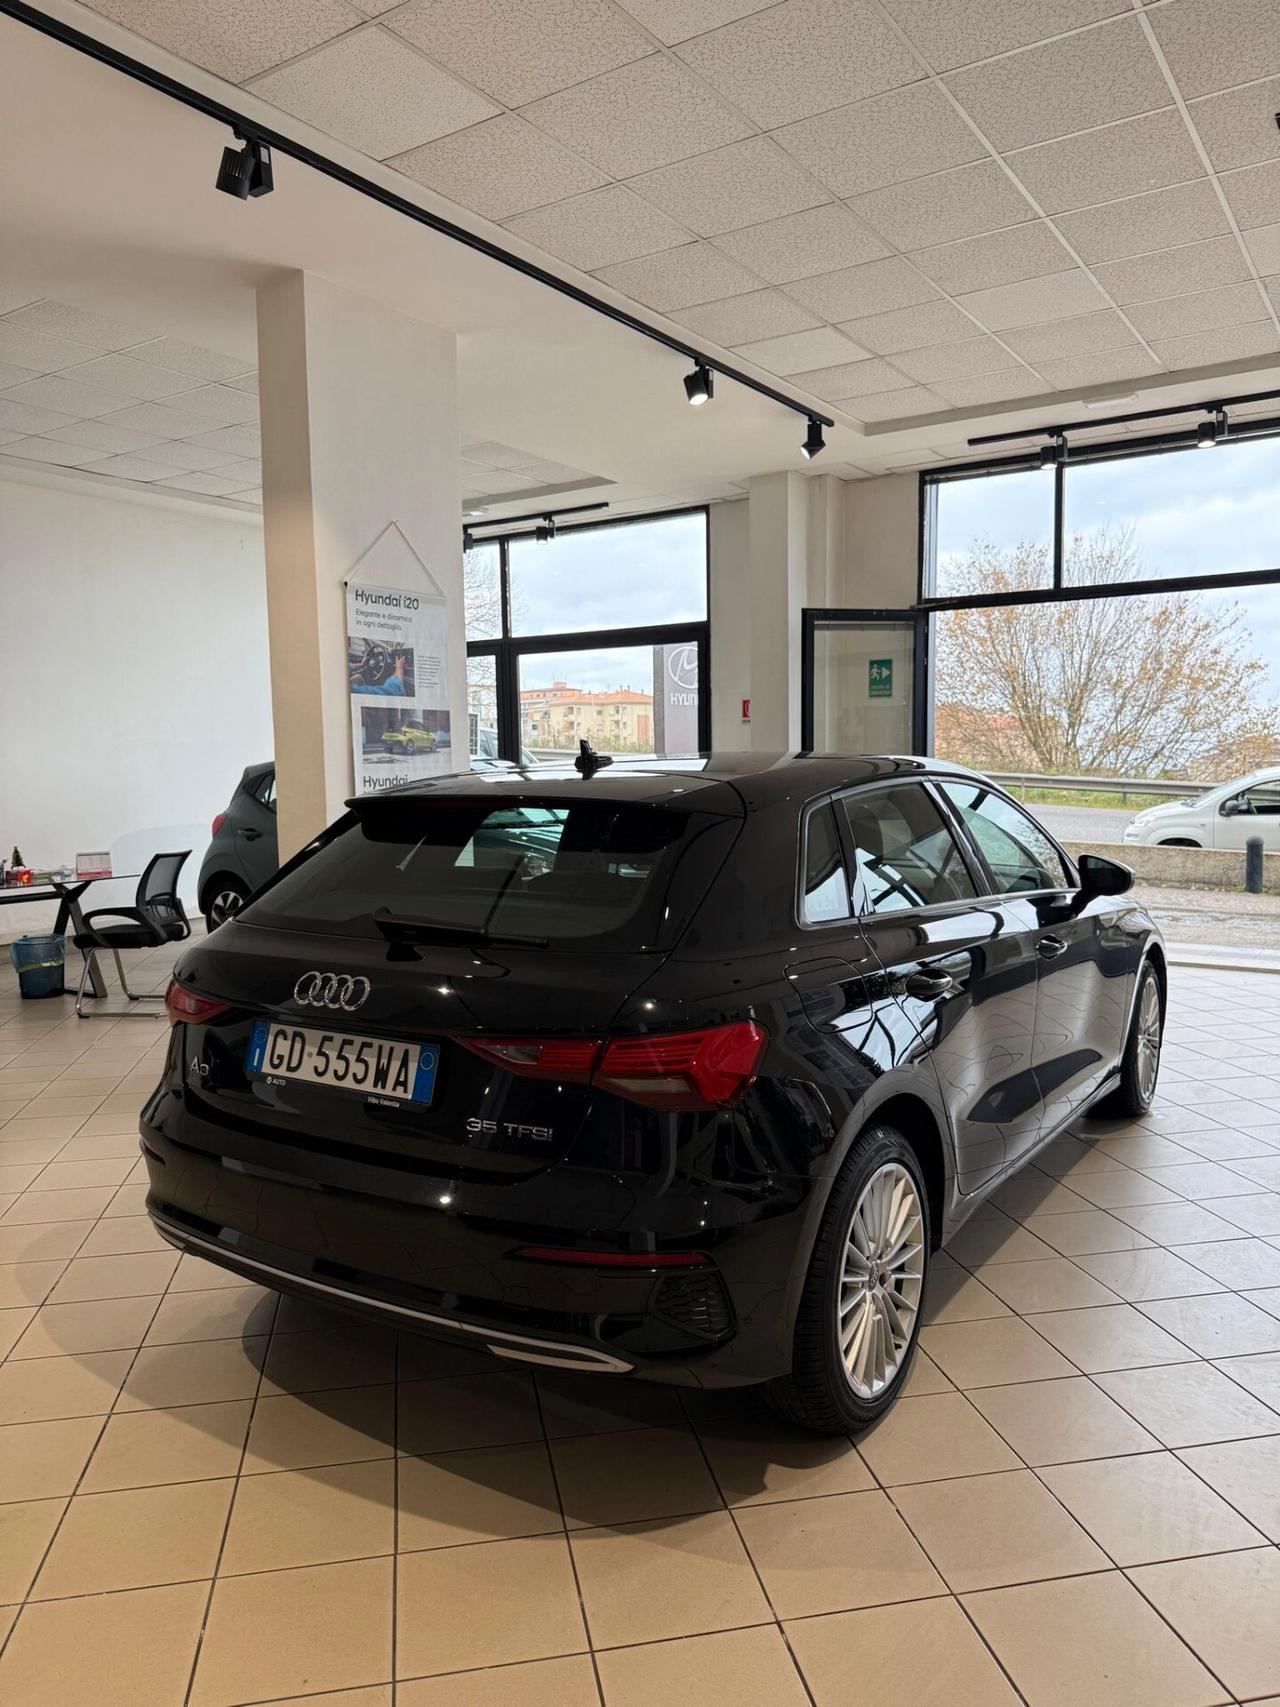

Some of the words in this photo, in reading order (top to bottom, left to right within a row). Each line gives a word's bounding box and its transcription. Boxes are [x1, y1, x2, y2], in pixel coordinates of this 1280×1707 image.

[355, 589, 401, 607] Hyundai
[404, 596, 419, 610] i20
[355, 608, 381, 619] Elegante
[387, 613, 413, 623] dinamica
[363, 620, 376, 629] ogni
[670, 692, 698, 706] HYUN
[363, 774, 408, 790] Hyundai
[190, 1056, 209, 1076] A3
[269, 1029, 306, 1074] GD
[313, 1035, 412, 1094] 555WA
[272, 1078, 287, 1087] AUTO
[466, 1118, 497, 1133] 35
